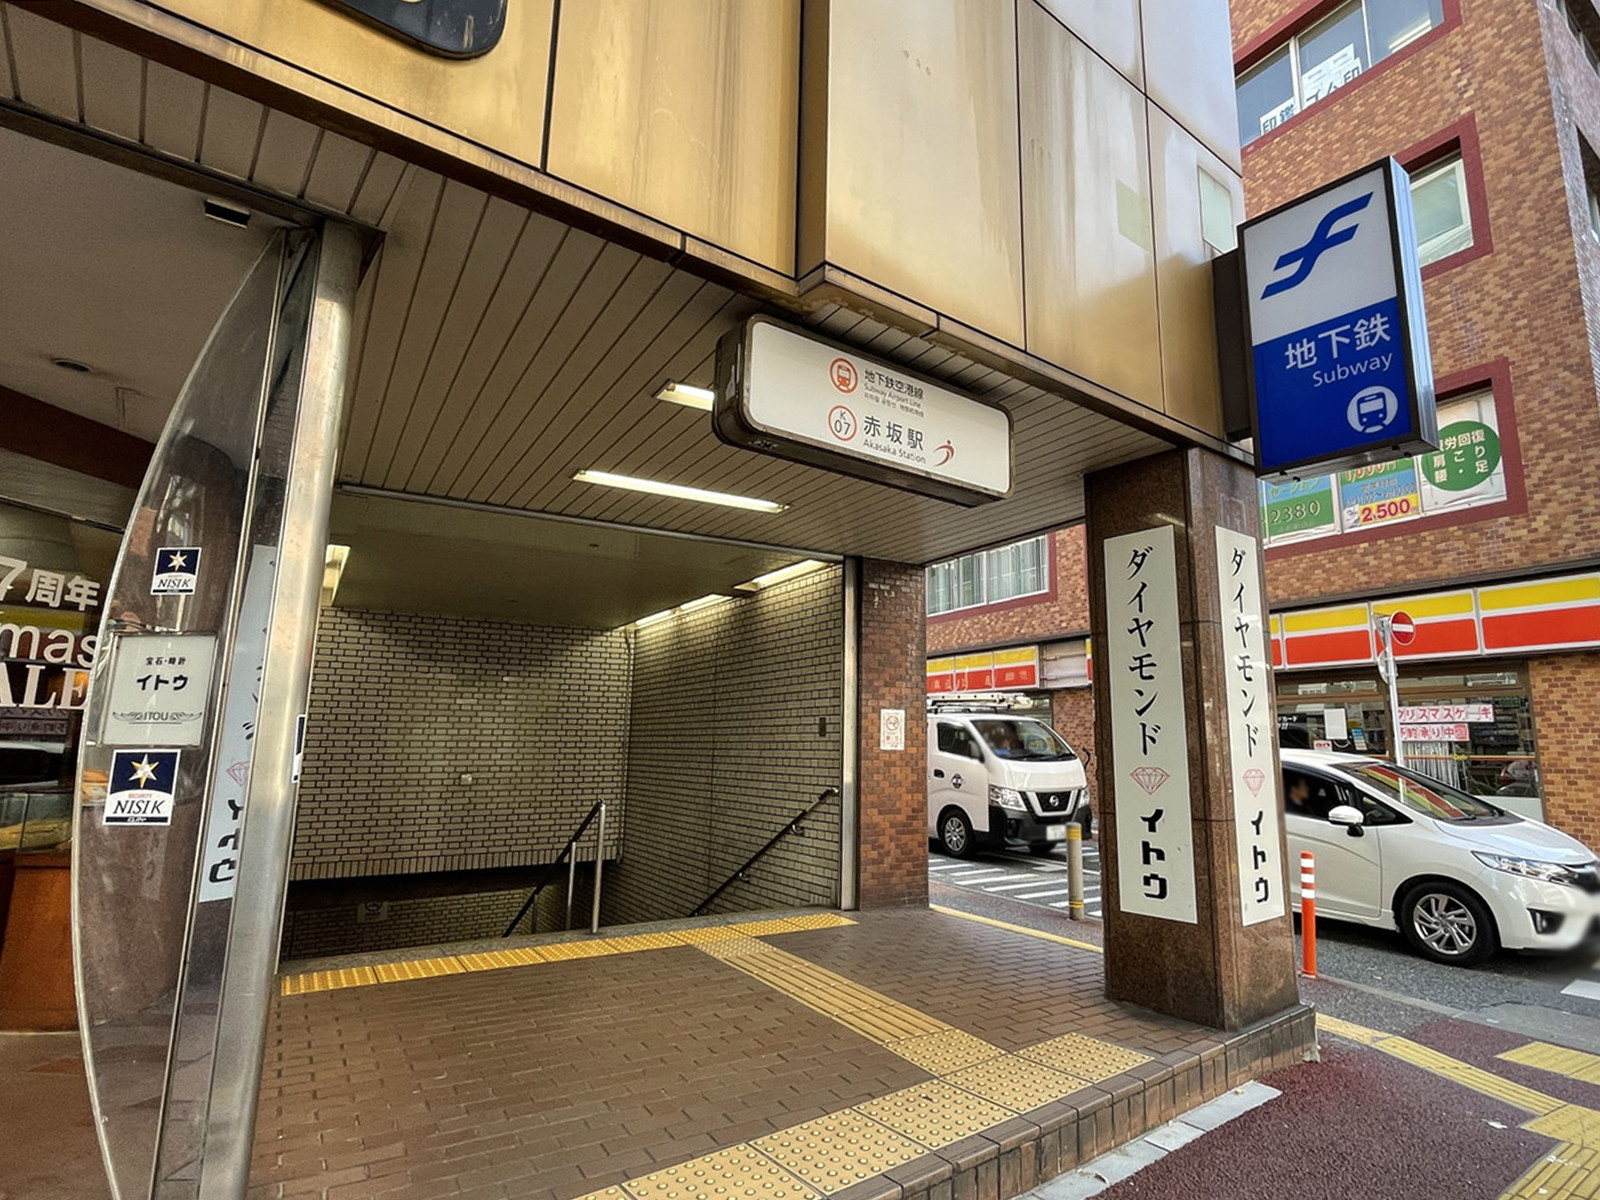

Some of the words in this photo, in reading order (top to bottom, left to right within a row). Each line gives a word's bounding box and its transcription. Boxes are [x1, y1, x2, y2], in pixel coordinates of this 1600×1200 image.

[1284, 313, 1392, 370] 地下鉄
[864, 368, 924, 399] 地下鉄空港線
[1312, 352, 1394, 388] Subway
[864, 383, 888, 398] Subway
[888, 391, 910, 405] Airport
[909, 398, 922, 409] Line
[834, 418, 852, 436] 07
[839, 410, 847, 420] K
[864, 416, 924, 451] 赤坂駅
[864, 440, 897, 456] Akasaka
[897, 448, 927, 464] Station
[1270, 499, 1321, 524] 2380
[0, 555, 101, 612] 7周年
[157, 578, 191, 589] NISIK
[1126, 546, 1161, 757] ダイヤモンド
[1230, 546, 1260, 758] ダイヤモンド
[135, 673, 190, 693] イトウ
[142, 711, 170, 722] ITOU
[113, 799, 166, 815] NISIK
[1139, 808, 1169, 901] イトウ
[1250, 809, 1270, 905] イトウ
